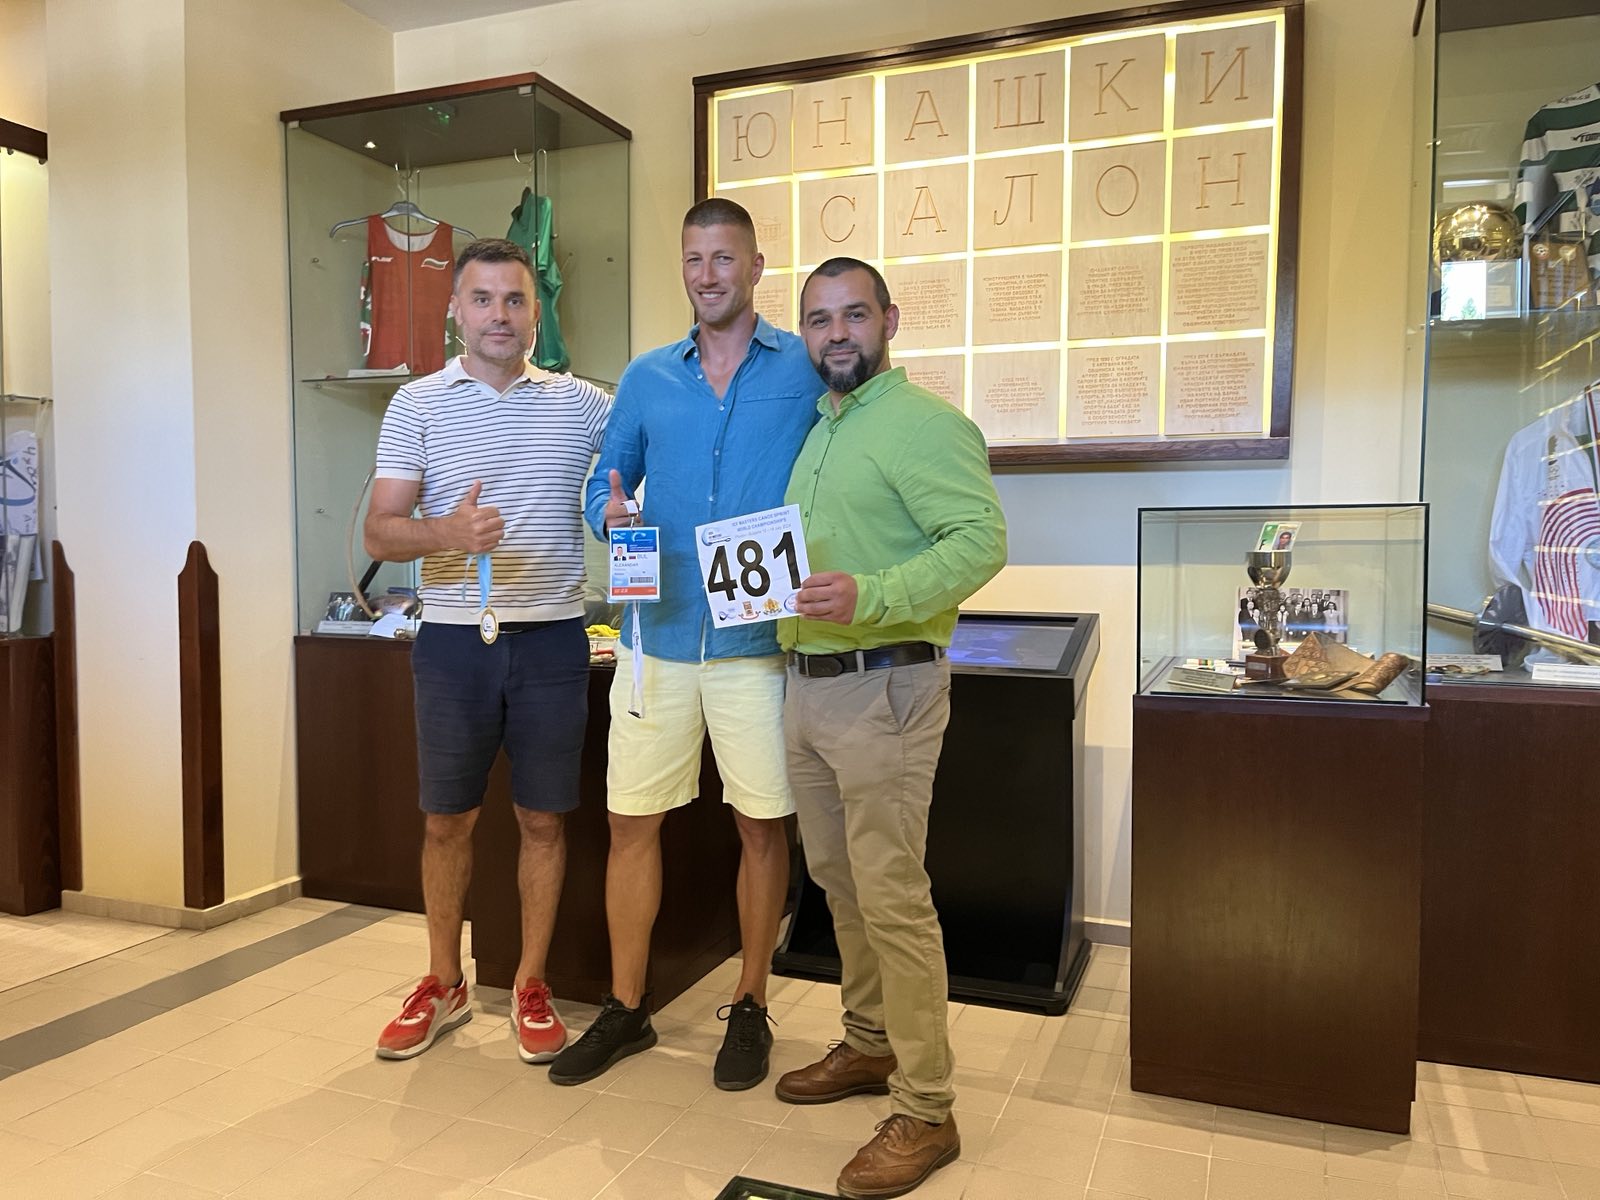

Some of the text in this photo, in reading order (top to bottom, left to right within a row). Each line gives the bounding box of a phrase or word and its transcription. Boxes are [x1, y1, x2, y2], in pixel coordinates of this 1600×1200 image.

[732, 47, 1250, 162] ЮНАШКИ
[820, 152, 1246, 244] САЛОН
[707, 531, 802, 601] 481
